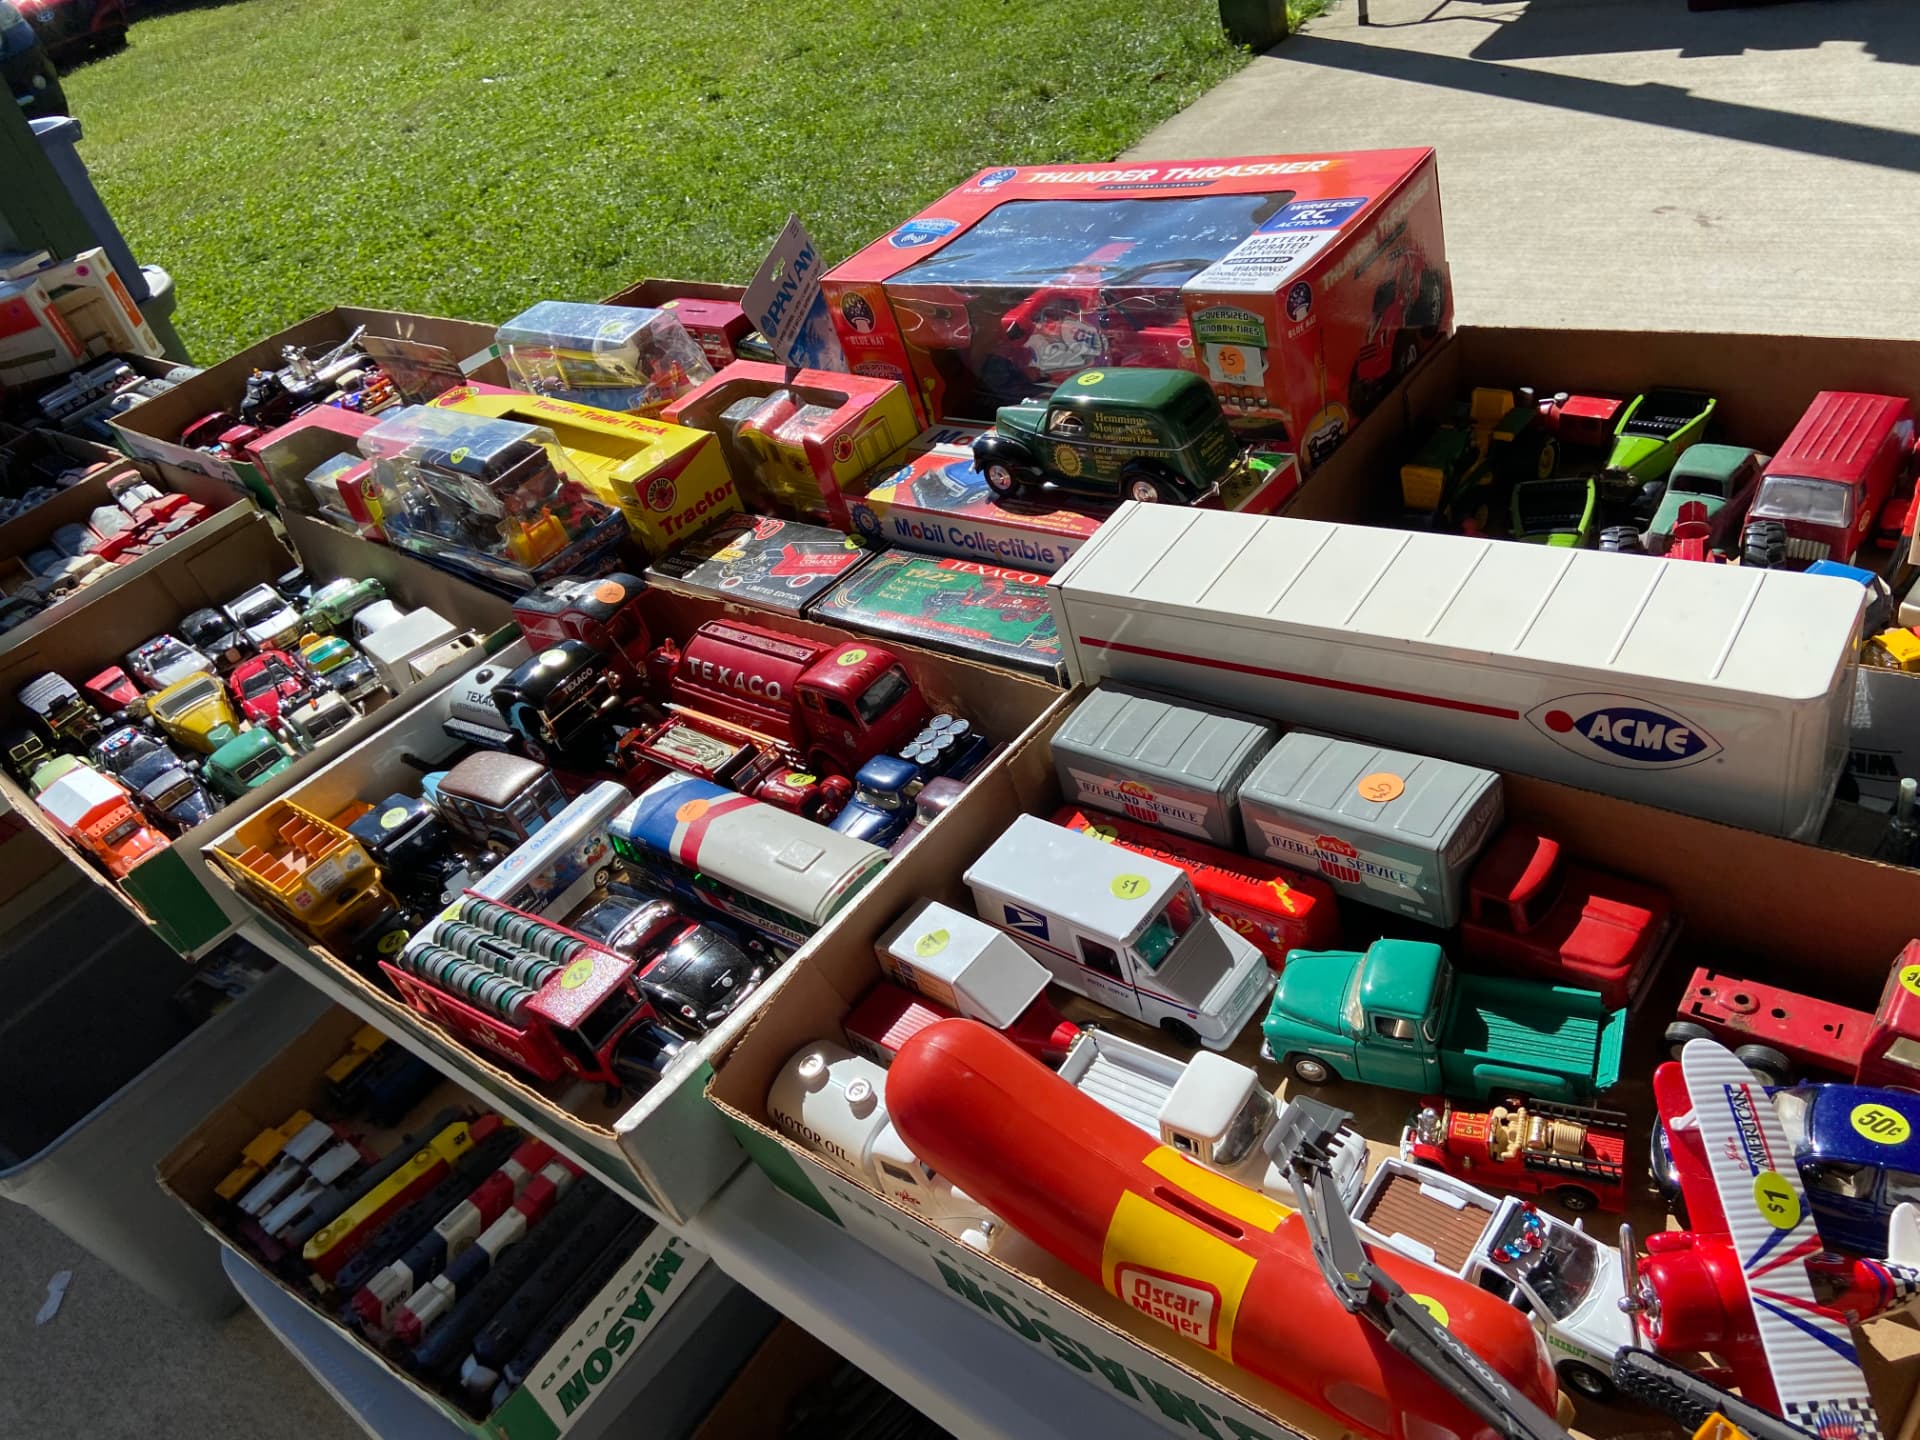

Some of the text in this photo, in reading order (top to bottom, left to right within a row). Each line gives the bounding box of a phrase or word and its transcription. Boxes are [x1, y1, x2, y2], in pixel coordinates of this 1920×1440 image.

[1028, 159, 1332, 185] THUNDER THRASHER
[1289, 201, 1359, 212] WIRELESS
[1290, 208, 1338, 221] RC
[1274, 218, 1333, 229] ACTION!
[1241, 242, 1311, 252] OPERATED
[1250, 235, 1319, 246] BATTERY
[767, 273, 800, 326] PAN
[793, 240, 817, 282] AM
[1205, 311, 1250, 321] OVERSIZED
[1236, 324, 1260, 337] TIRES
[1219, 351, 1237, 367] $5
[531, 399, 669, 437] Tractor Trailer Truck
[1093, 422, 1121, 434] Motor
[1095, 411, 1148, 427] Hemmings
[658, 479, 734, 537] Tractor
[895, 518, 946, 545] Mobil
[950, 526, 1055, 563] Collectible
[905, 568, 958, 584] 1925
[950, 560, 1041, 585] TEXACO
[746, 585, 804, 602] LIMITED EDITION
[562, 667, 594, 696] TEXACO
[686, 655, 783, 702] TEXACO
[465, 690, 497, 708] TEXAC
[1586, 714, 1691, 756] ACME
[1081, 782, 1200, 824] OVERLAND SERVICE
[1271, 834, 1410, 884] OVERLAND SERVICE
[1121, 880, 1140, 895] $1
[772, 1108, 825, 1150] MOTOR
[1730, 1086, 1770, 1170] AMERICAN
[1856, 1109, 1904, 1137] 50¢
[1762, 1188, 1792, 1216] $1
[1133, 1277, 1202, 1317] Oscar
[540, 1251, 657, 1391] RECYCLED
[1131, 1295, 1204, 1337] Mayer
[1548, 1334, 1589, 1359] SHERIFF
